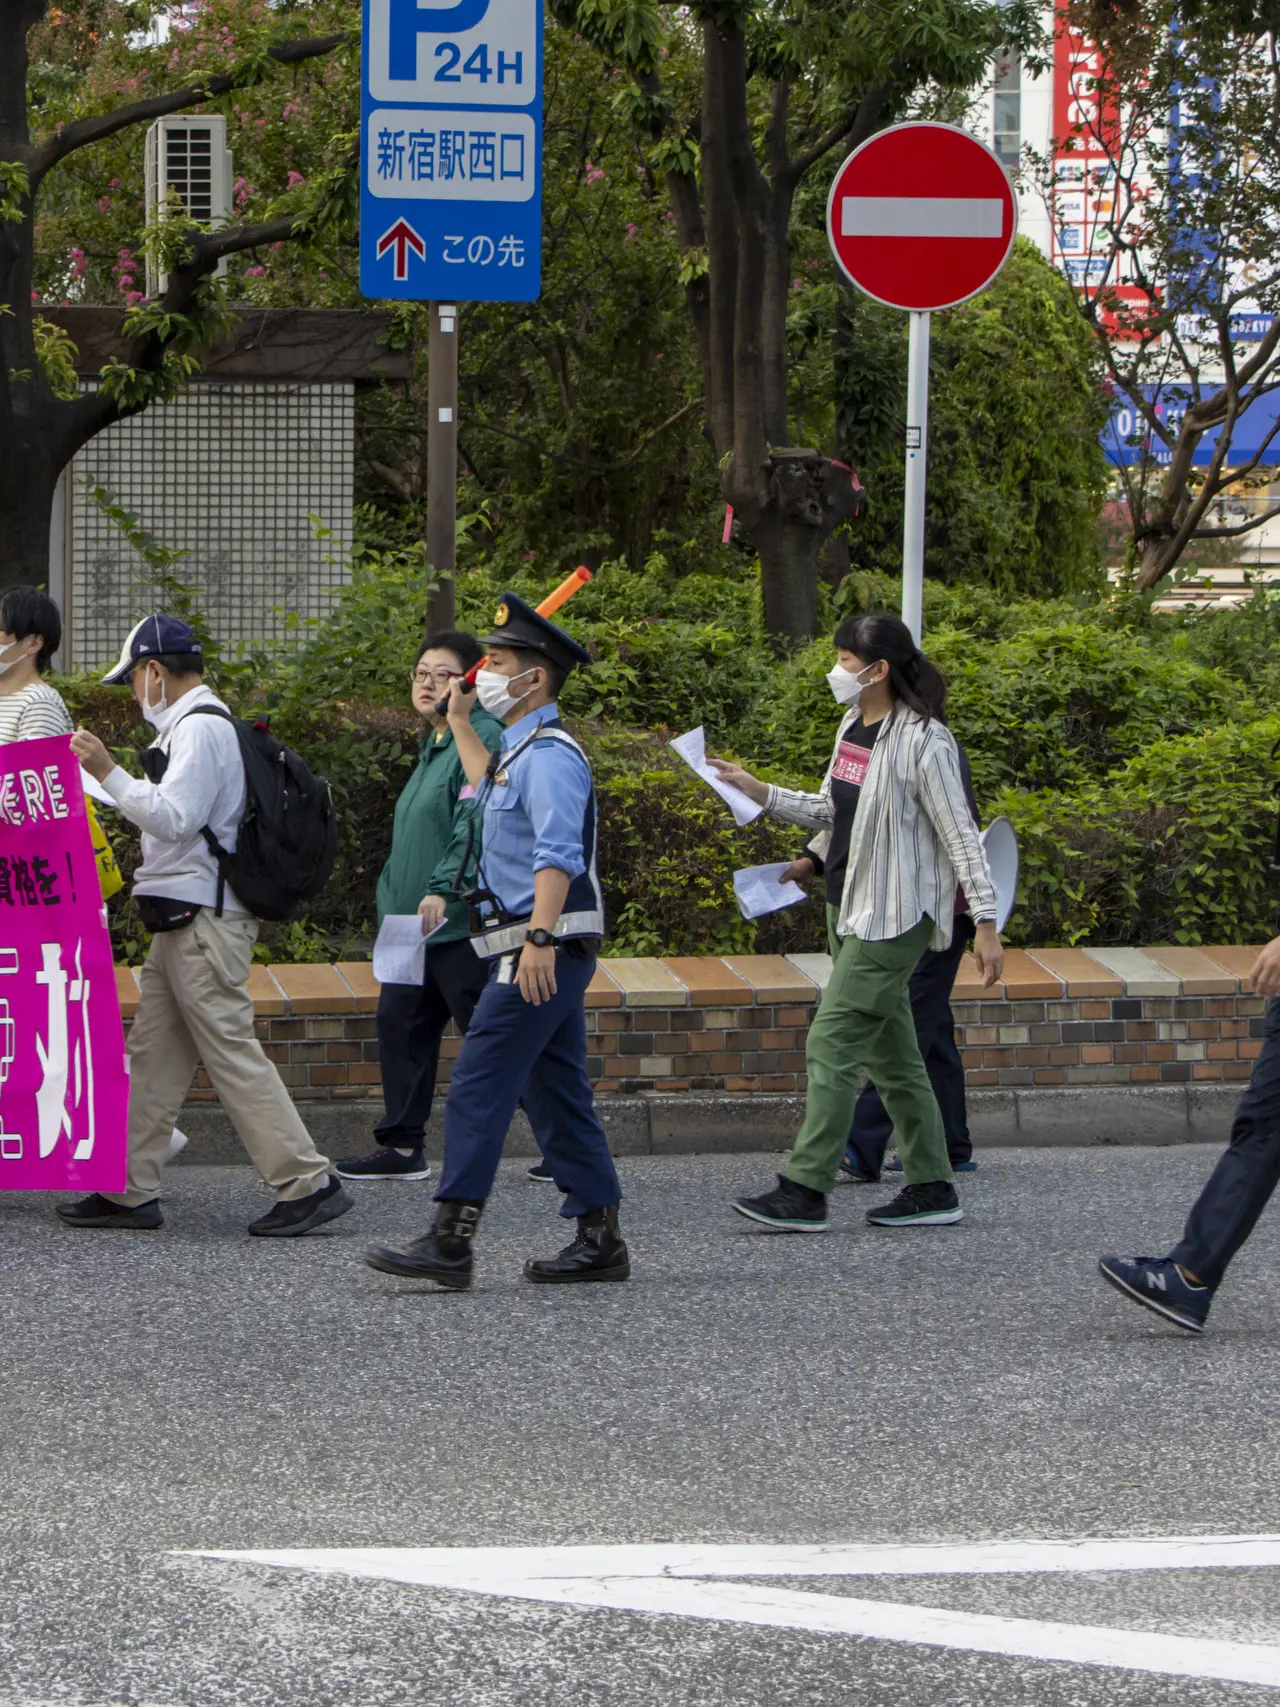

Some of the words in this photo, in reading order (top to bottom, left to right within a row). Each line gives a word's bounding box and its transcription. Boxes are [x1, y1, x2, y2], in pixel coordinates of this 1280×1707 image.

[388, 0, 492, 81] P
[433, 41, 523, 85] 24H
[377, 127, 525, 182] 新宿駅西口
[442, 234, 525, 268] この先
[1146, 1271, 1167, 1292] N
